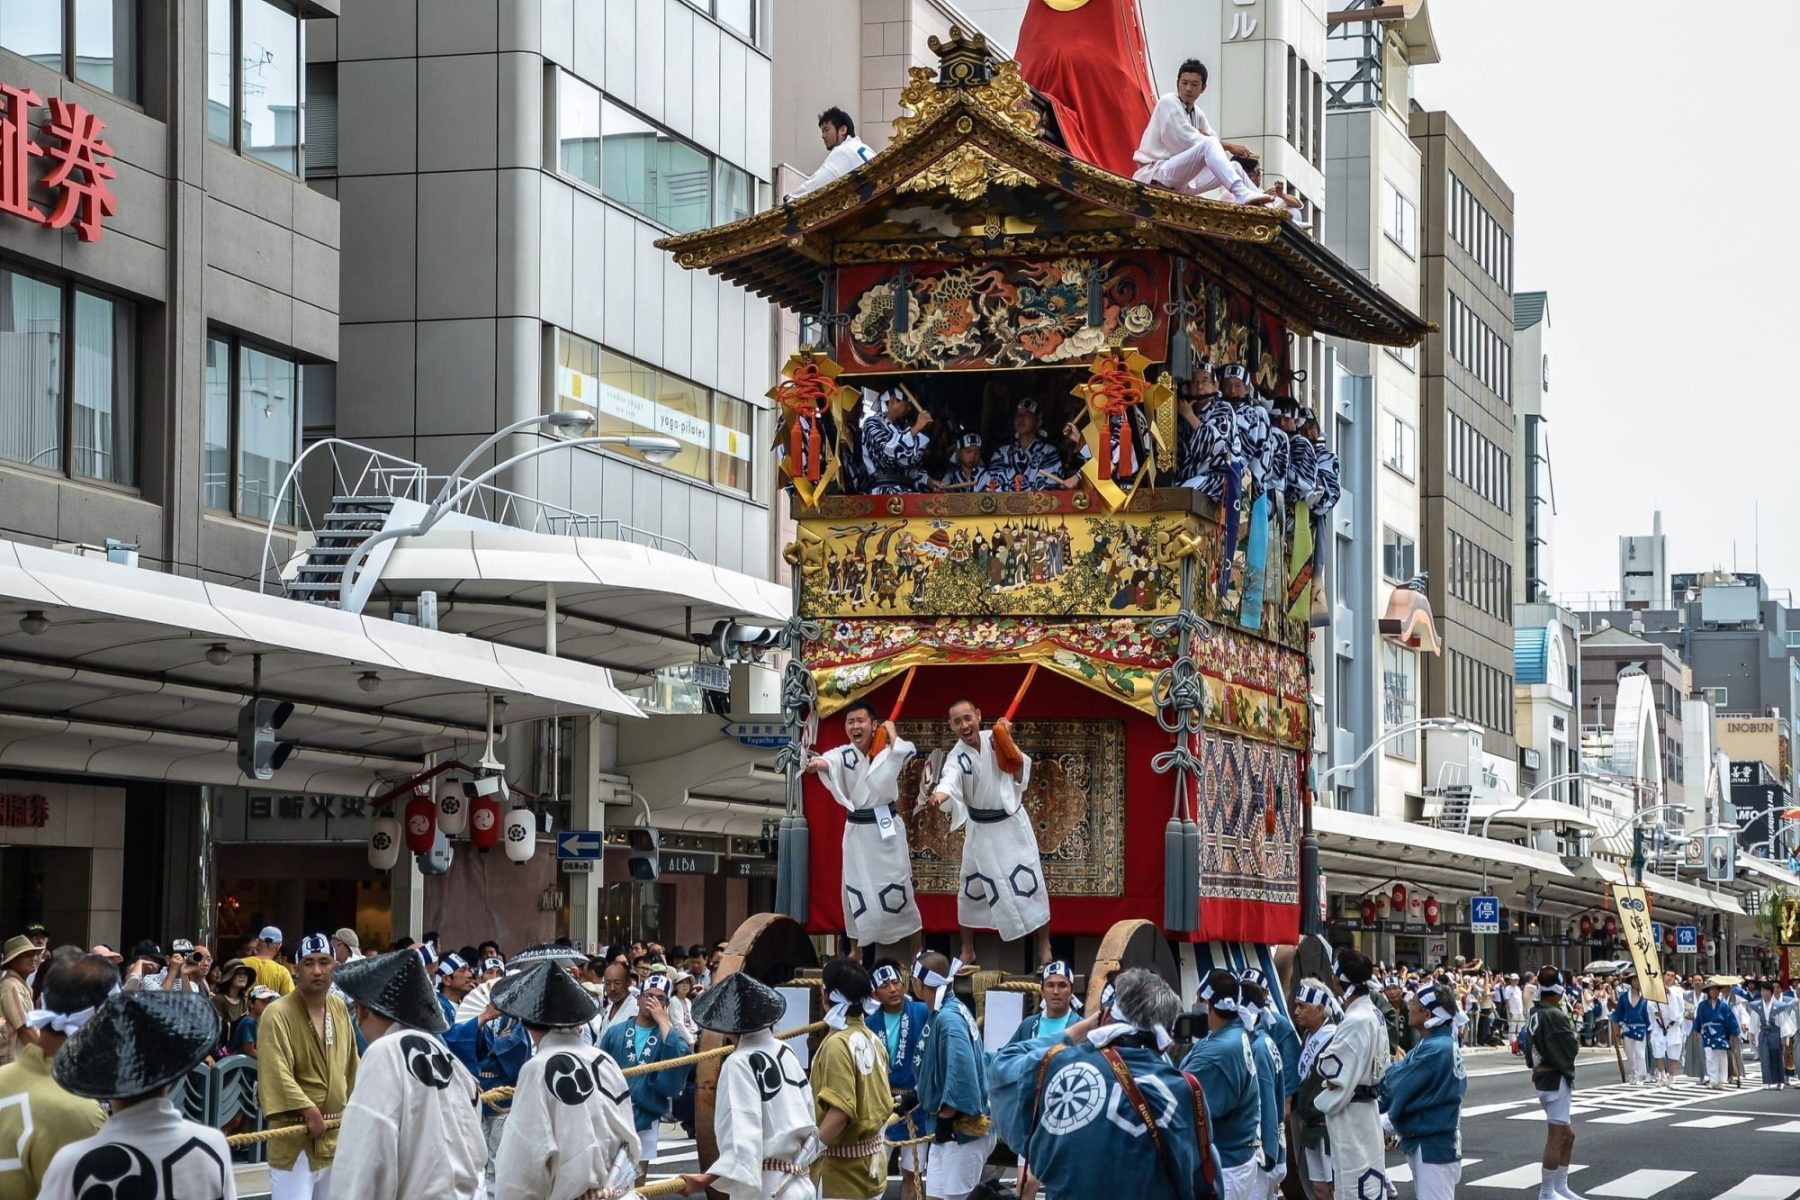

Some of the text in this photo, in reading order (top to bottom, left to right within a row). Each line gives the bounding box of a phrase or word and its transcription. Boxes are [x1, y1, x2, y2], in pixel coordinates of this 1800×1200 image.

[1229, 0, 1257, 40] ル
[1727, 722, 1774, 733] INOBUN
[669, 857, 696, 871] ALBA
[1475, 901, 1495, 920] 停
[1472, 924, 1498, 932] ここまで
[625, 1039, 636, 1062] 東方
[912, 1039, 926, 1067] 東方
[1138, 1103, 1157, 1138] Canon
